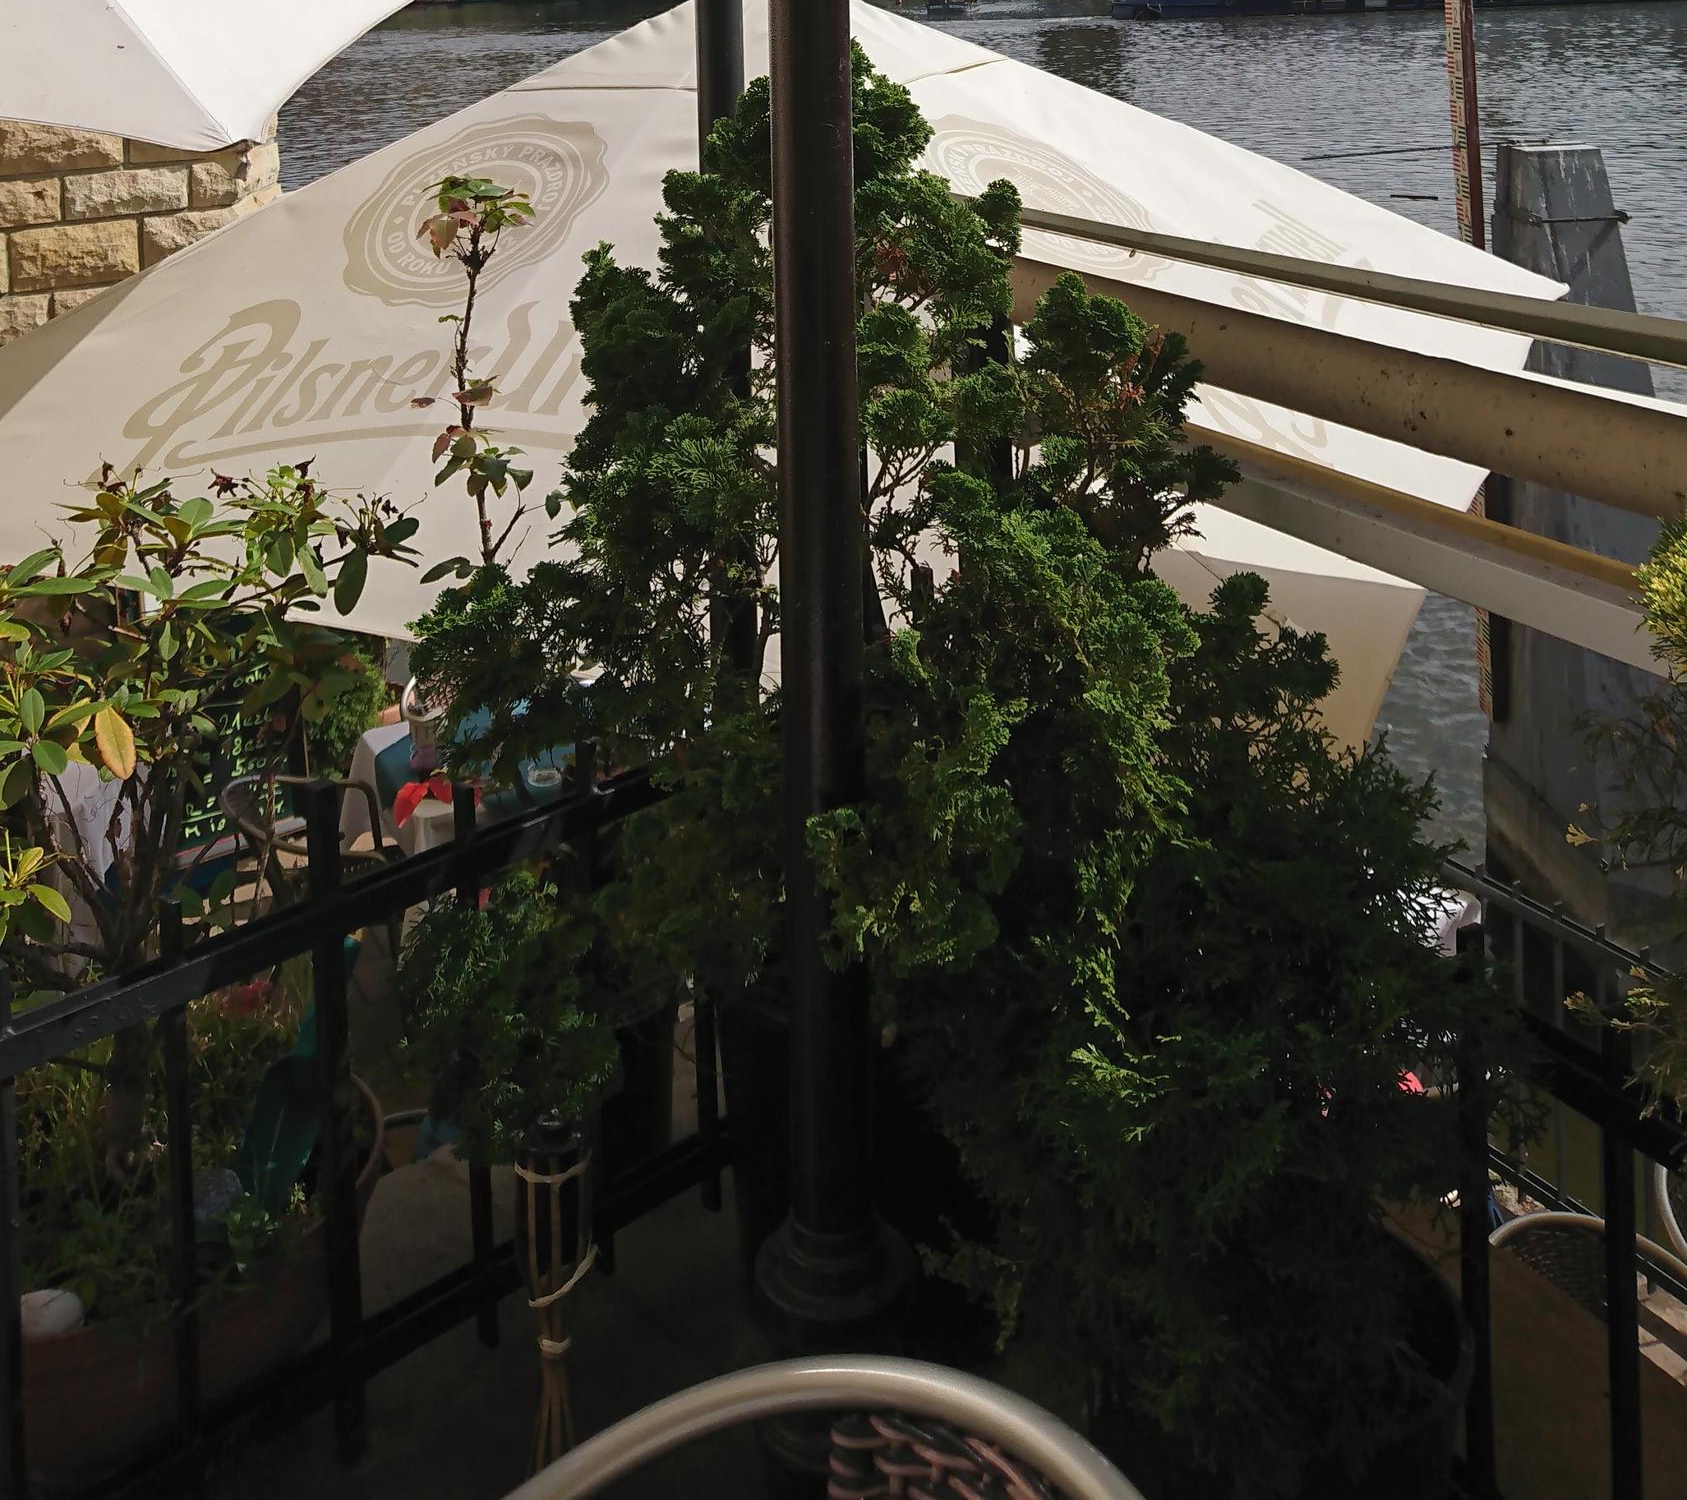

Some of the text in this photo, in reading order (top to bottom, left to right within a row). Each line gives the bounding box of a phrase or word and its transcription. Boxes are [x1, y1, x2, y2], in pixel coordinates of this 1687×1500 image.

[386, 232, 403, 255] OD
[400, 252, 452, 276] ROKU
[88, 299, 494, 490] Pilsner
